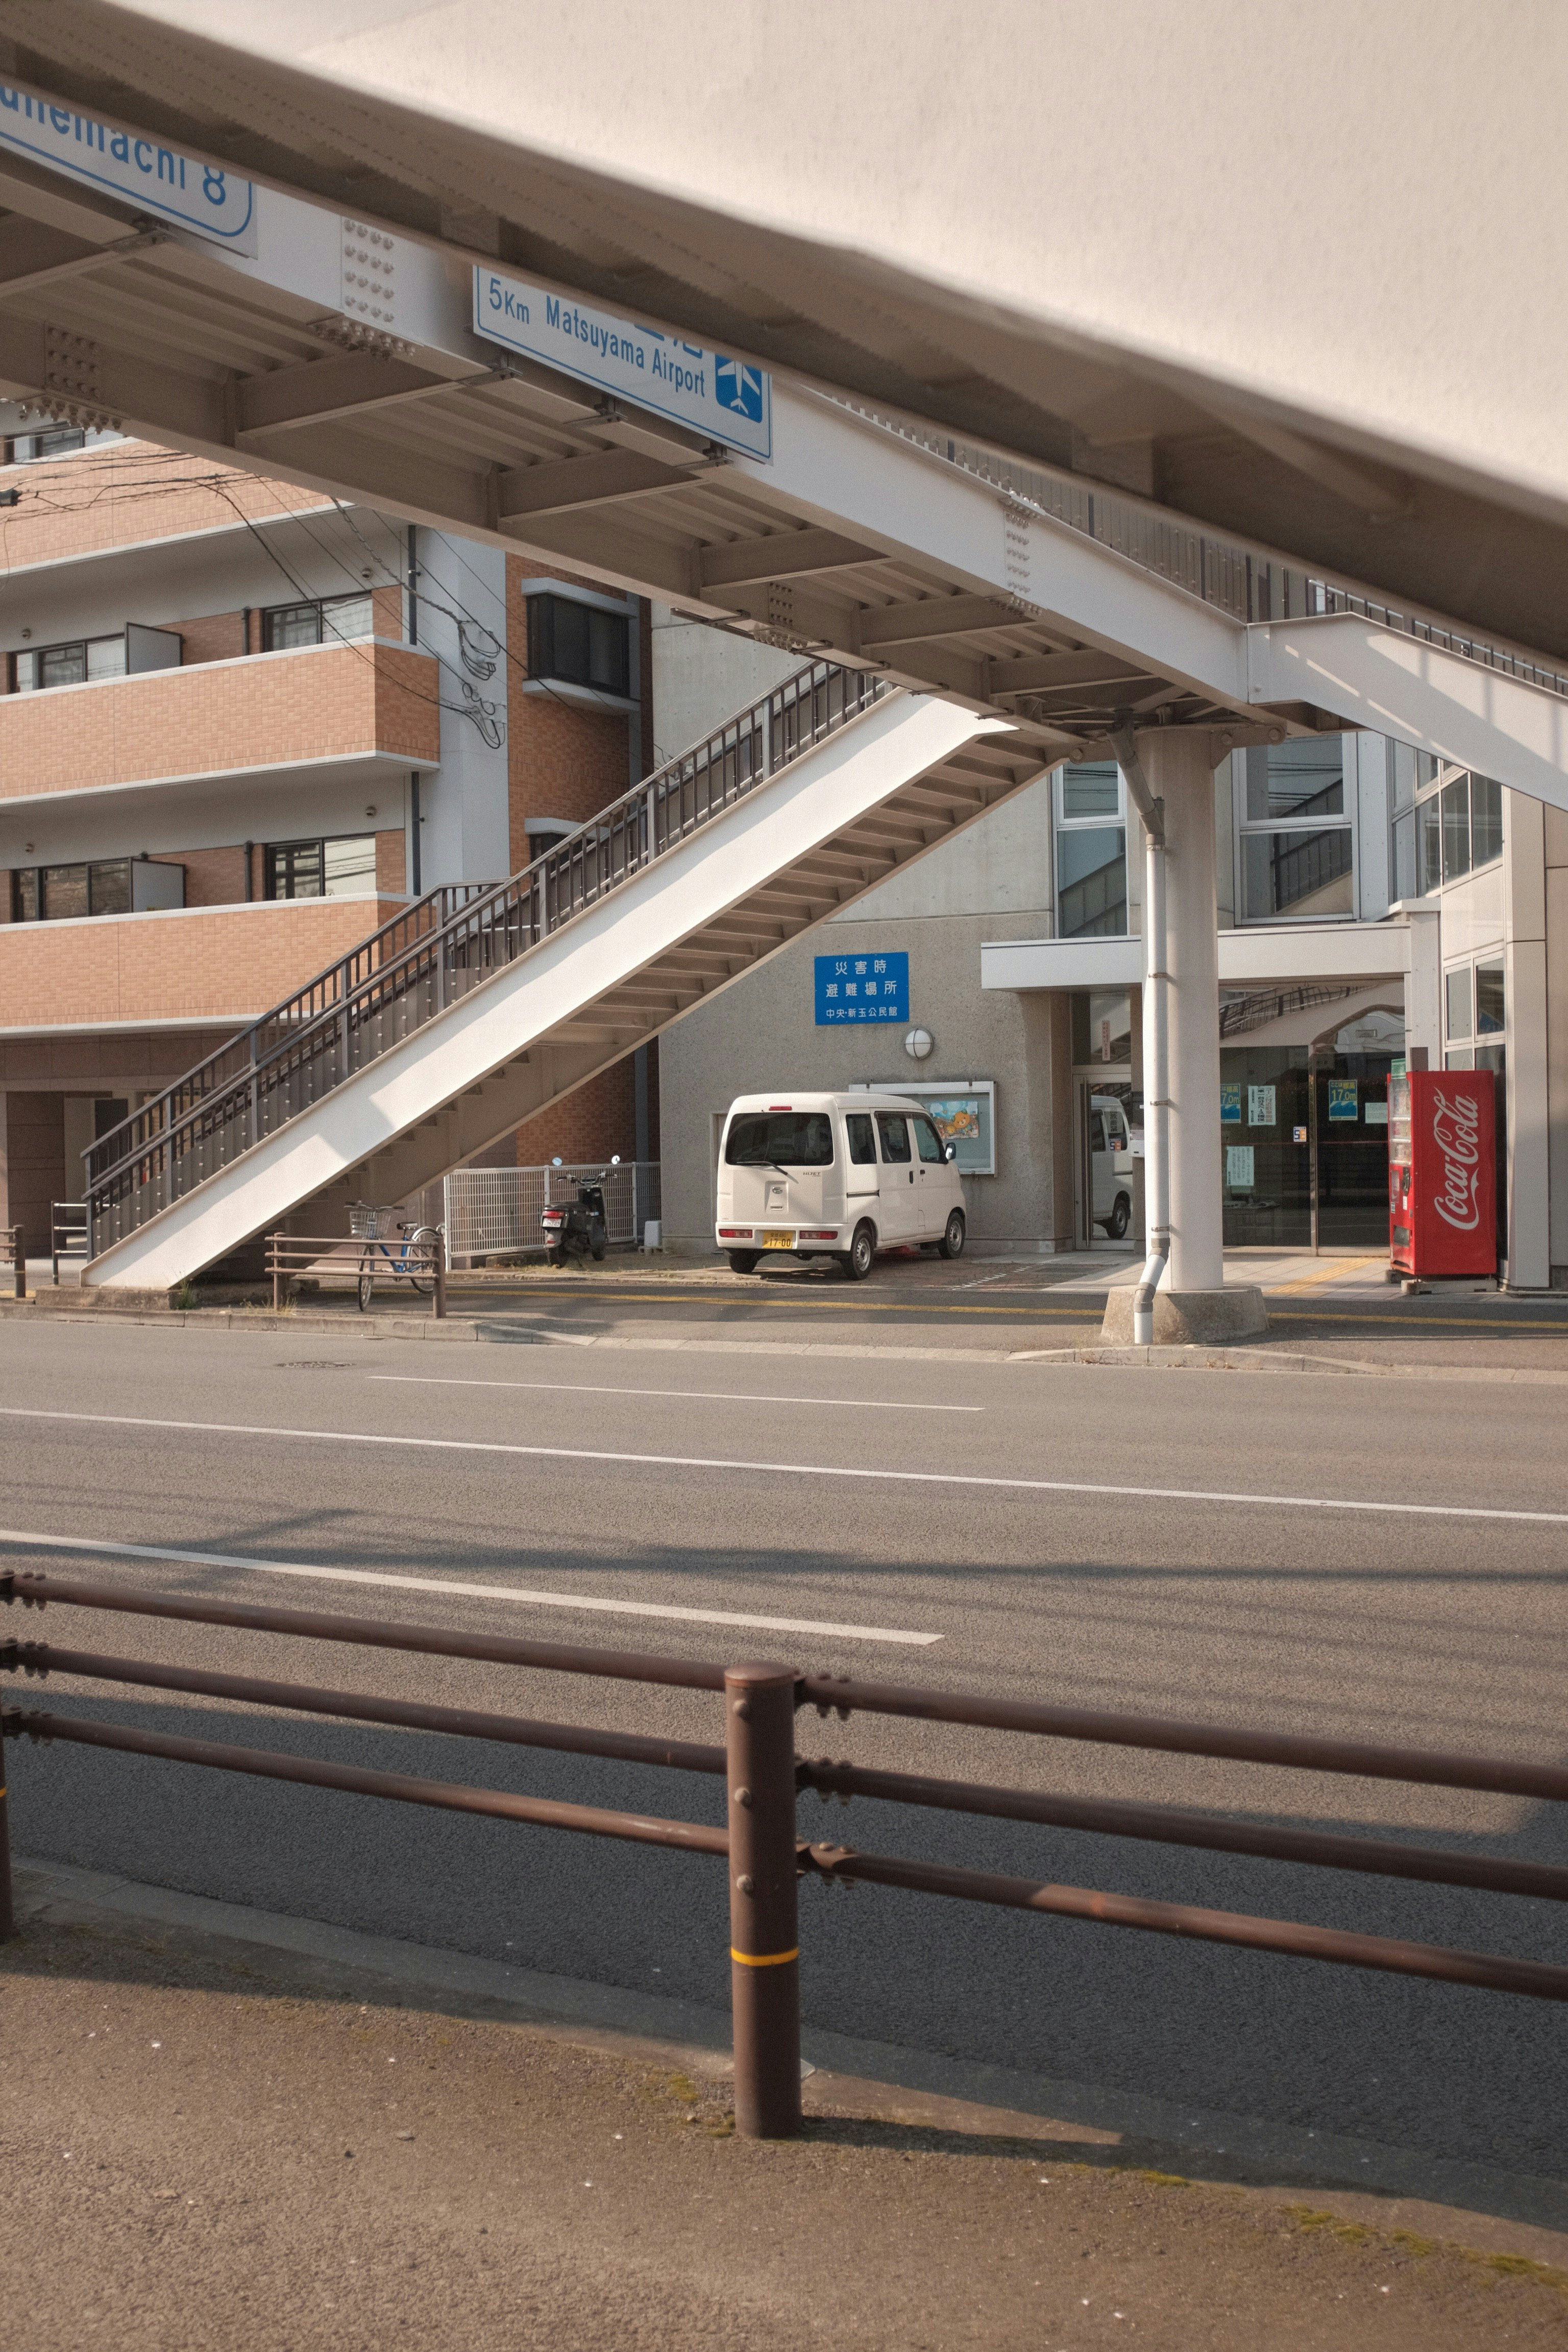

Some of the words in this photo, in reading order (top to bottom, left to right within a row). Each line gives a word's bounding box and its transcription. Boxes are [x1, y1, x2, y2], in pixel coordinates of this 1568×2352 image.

[203, 164, 226, 206] 8
[546, 295, 644, 370] Matsuyama
[652, 348, 705, 398] Airport
[836, 959, 887, 975] 災害時
[826, 980, 897, 998] 避難場所
[826, 1006, 897, 1019] 中央・新玉公民館
[1332, 1089, 1356, 1101] 17.0m
[1434, 1087, 1479, 1230] Coca-Cola
[770, 1238, 791, 1247] 17-00
